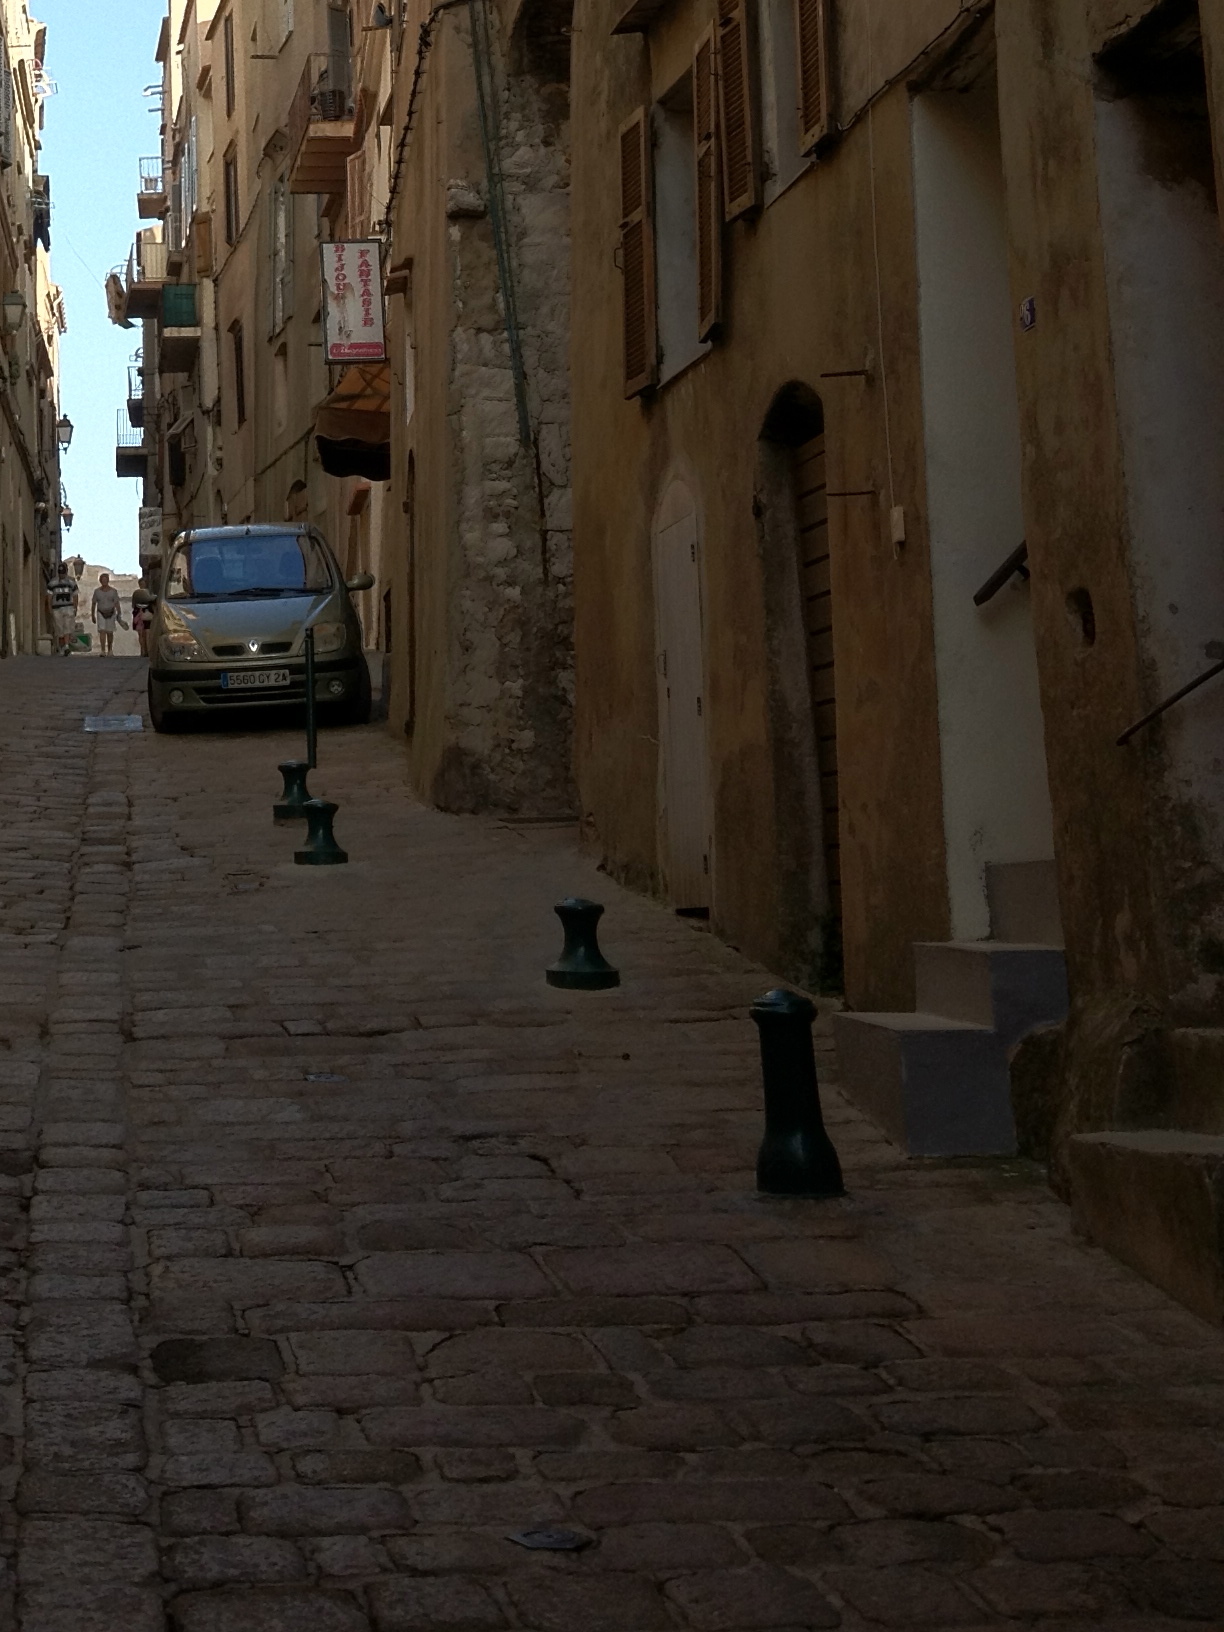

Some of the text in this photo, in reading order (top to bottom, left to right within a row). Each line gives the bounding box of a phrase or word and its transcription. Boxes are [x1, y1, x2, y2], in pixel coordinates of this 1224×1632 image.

[358, 249, 375, 328] FANTASIE
[229, 674, 256, 686] 5560
[274, 672, 288, 683] 2A
